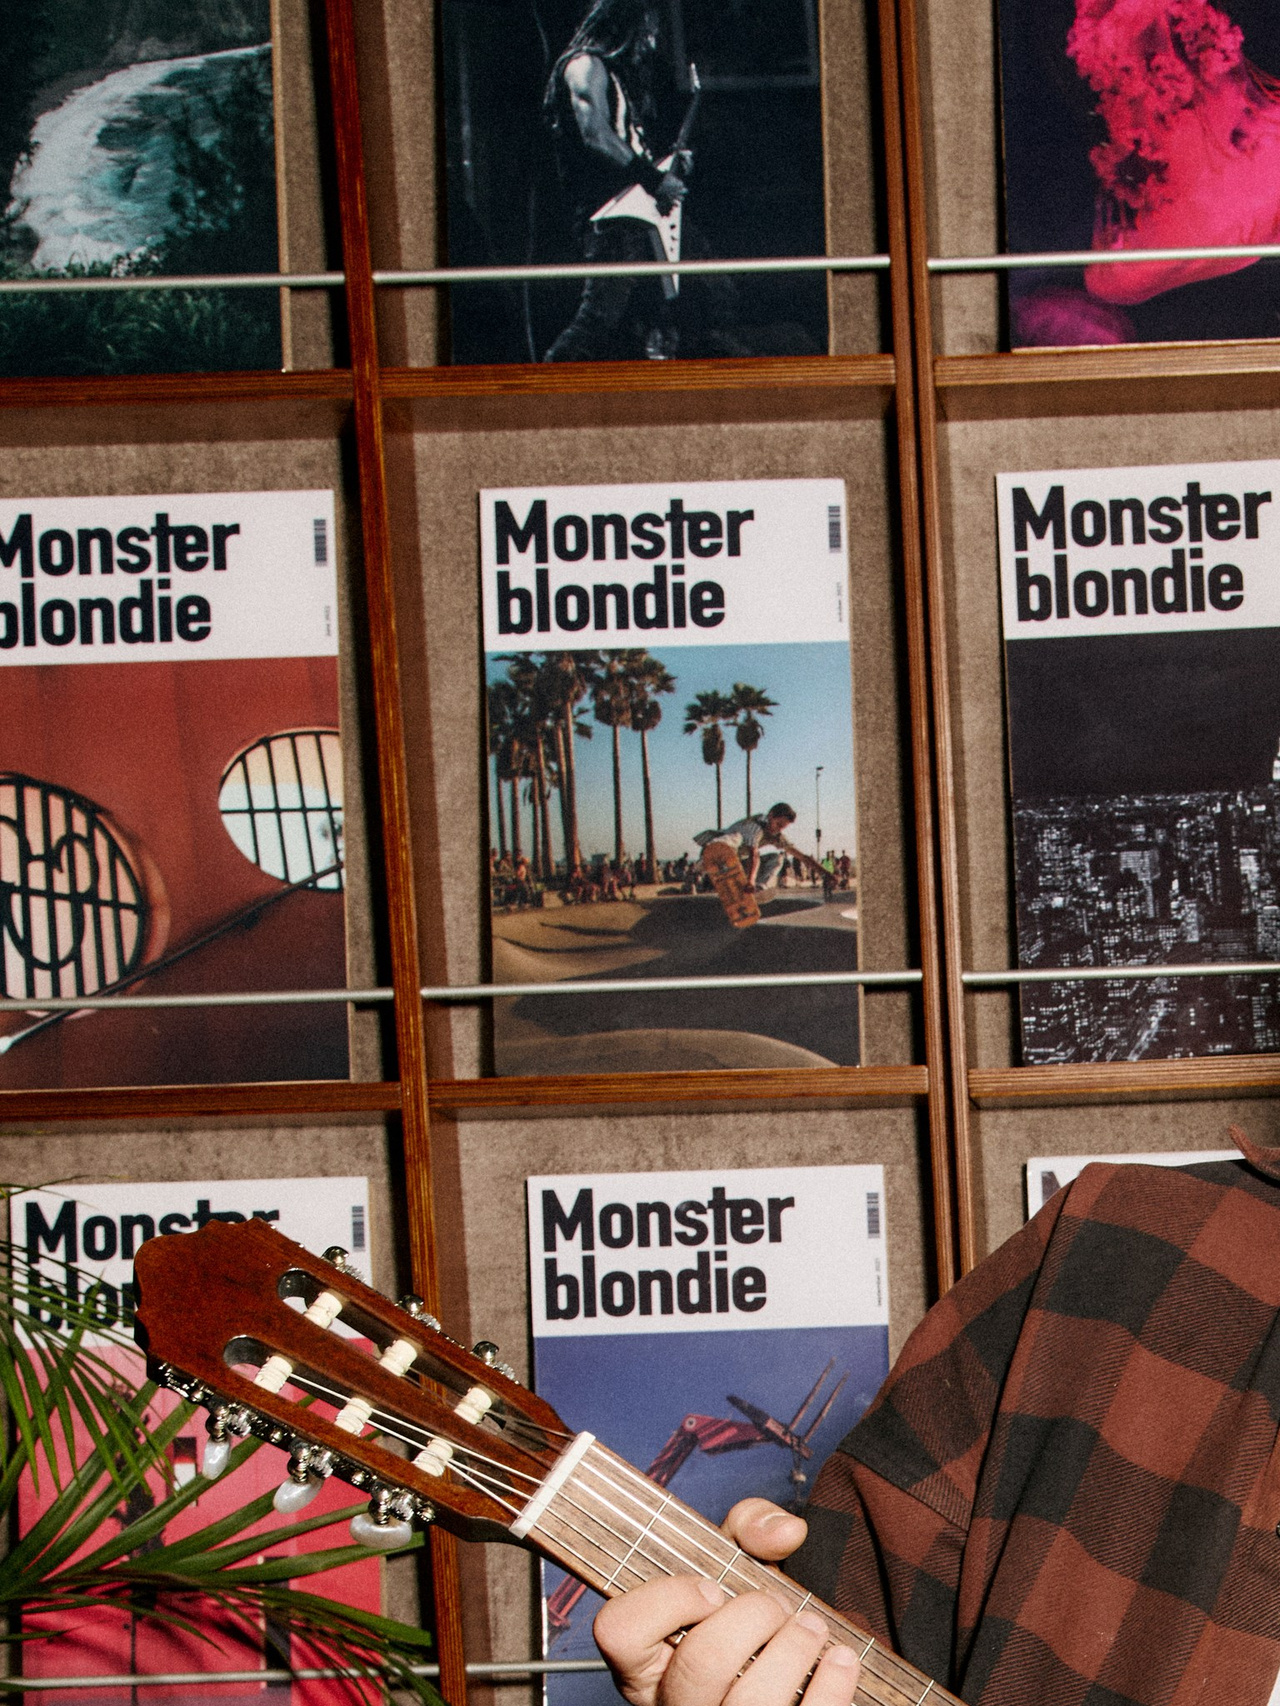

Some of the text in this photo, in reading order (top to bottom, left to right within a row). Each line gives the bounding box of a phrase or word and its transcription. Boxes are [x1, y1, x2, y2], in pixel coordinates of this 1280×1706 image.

[0, 513, 241, 579] Monster
[494, 499, 755, 566] Monster
[1012, 482, 1272, 551] Monster
[496, 565, 726, 635] blondie
[1015, 548, 1244, 622] blondie
[541, 1187, 795, 1253] Monster
[544, 1251, 767, 1321] blondie
